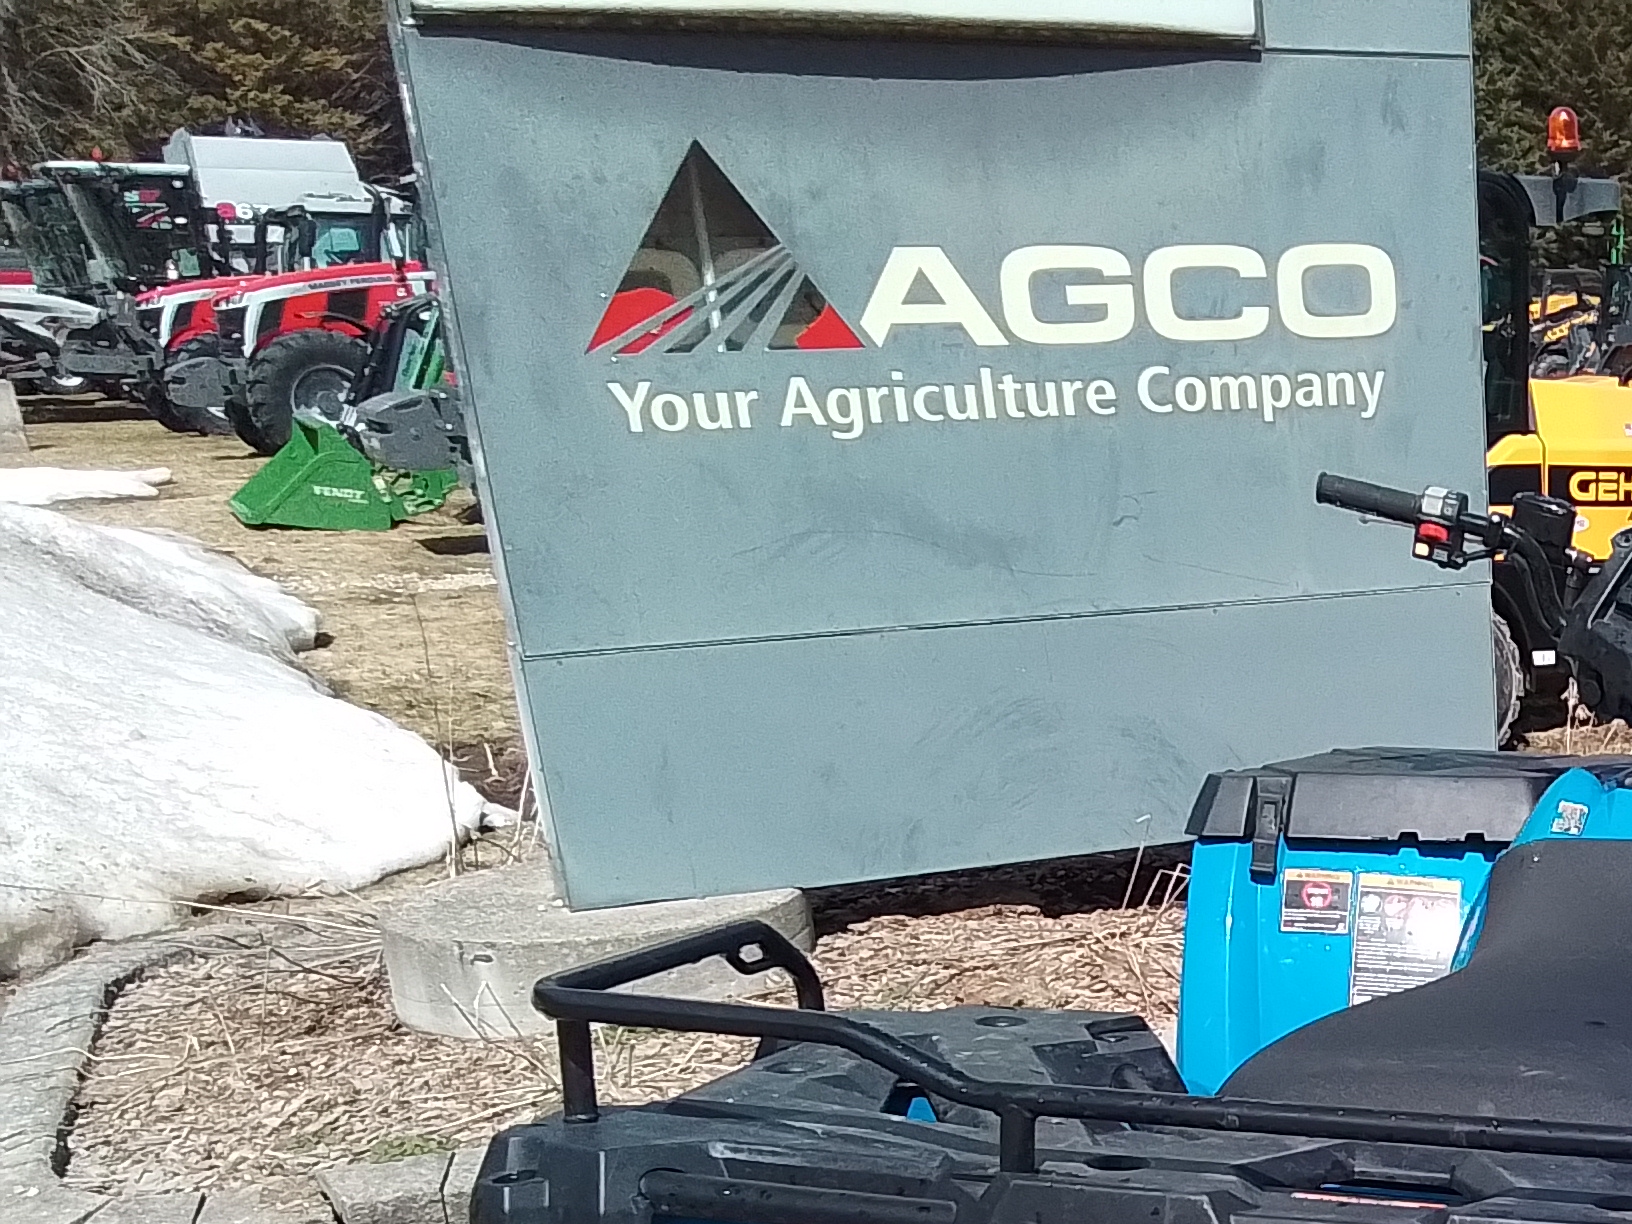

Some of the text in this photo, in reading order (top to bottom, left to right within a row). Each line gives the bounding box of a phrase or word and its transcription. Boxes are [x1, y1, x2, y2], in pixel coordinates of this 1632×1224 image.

[858, 243, 1398, 348] AGCO
[606, 364, 1386, 440] Your Agriculture Company
